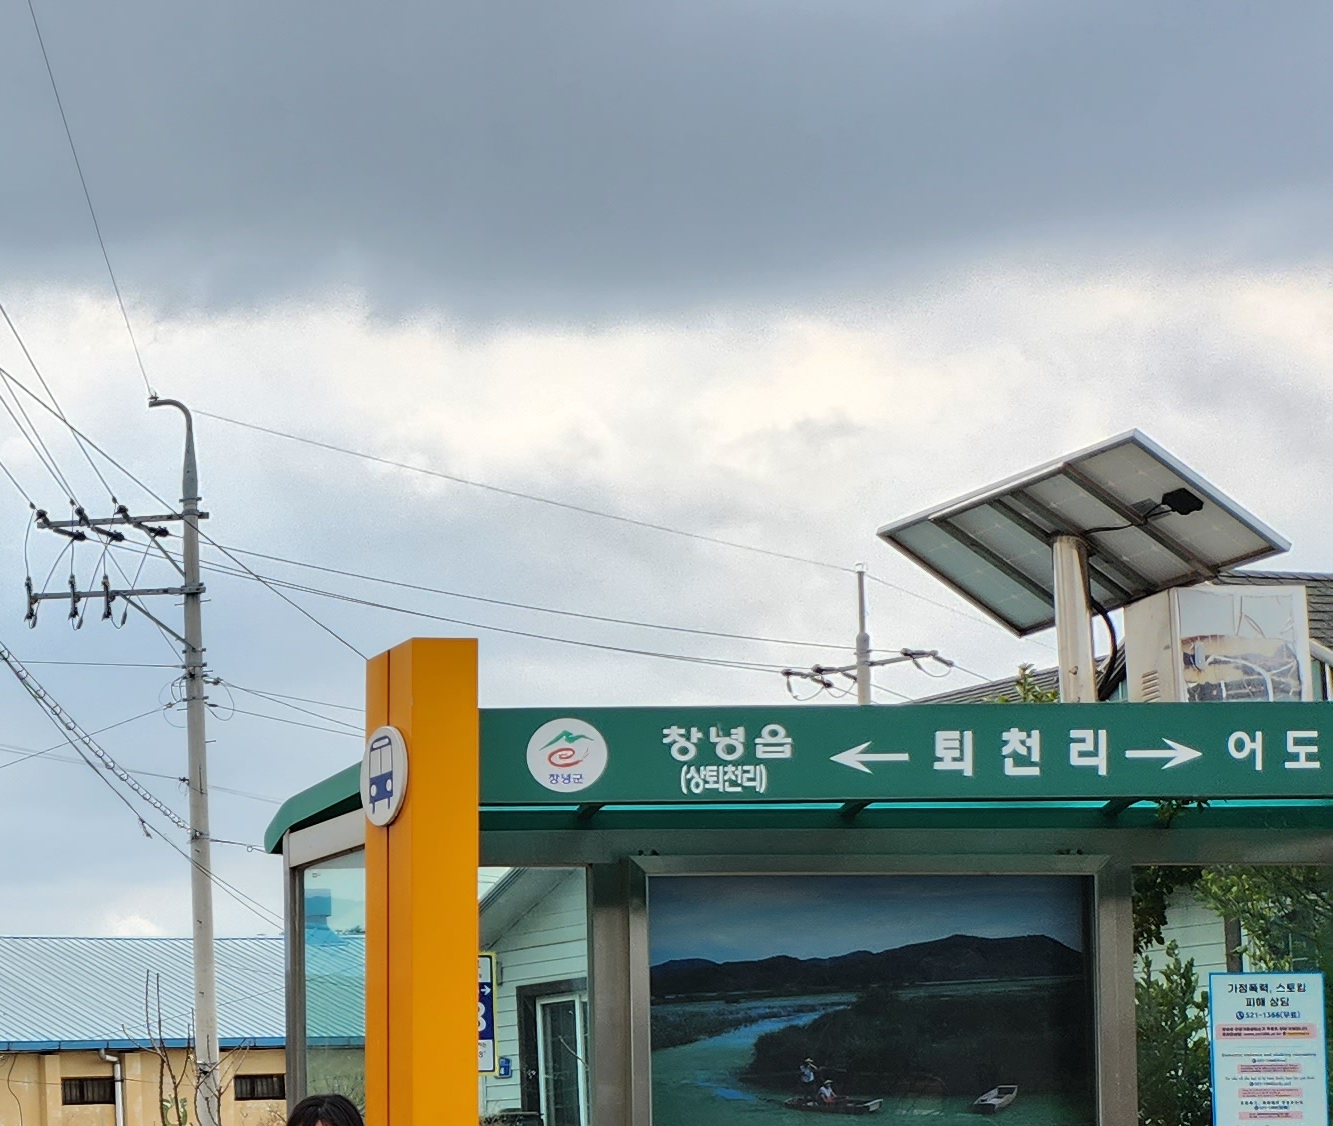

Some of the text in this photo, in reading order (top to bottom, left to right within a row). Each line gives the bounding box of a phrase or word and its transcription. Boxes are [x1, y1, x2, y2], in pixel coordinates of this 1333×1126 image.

[662, 724, 792, 761] 창녕읍
[933, 727, 1108, 777] 퇴천리
[548, 773, 583, 784] 창녕군
[680, 764, 767, 794] (상퇴천리)
